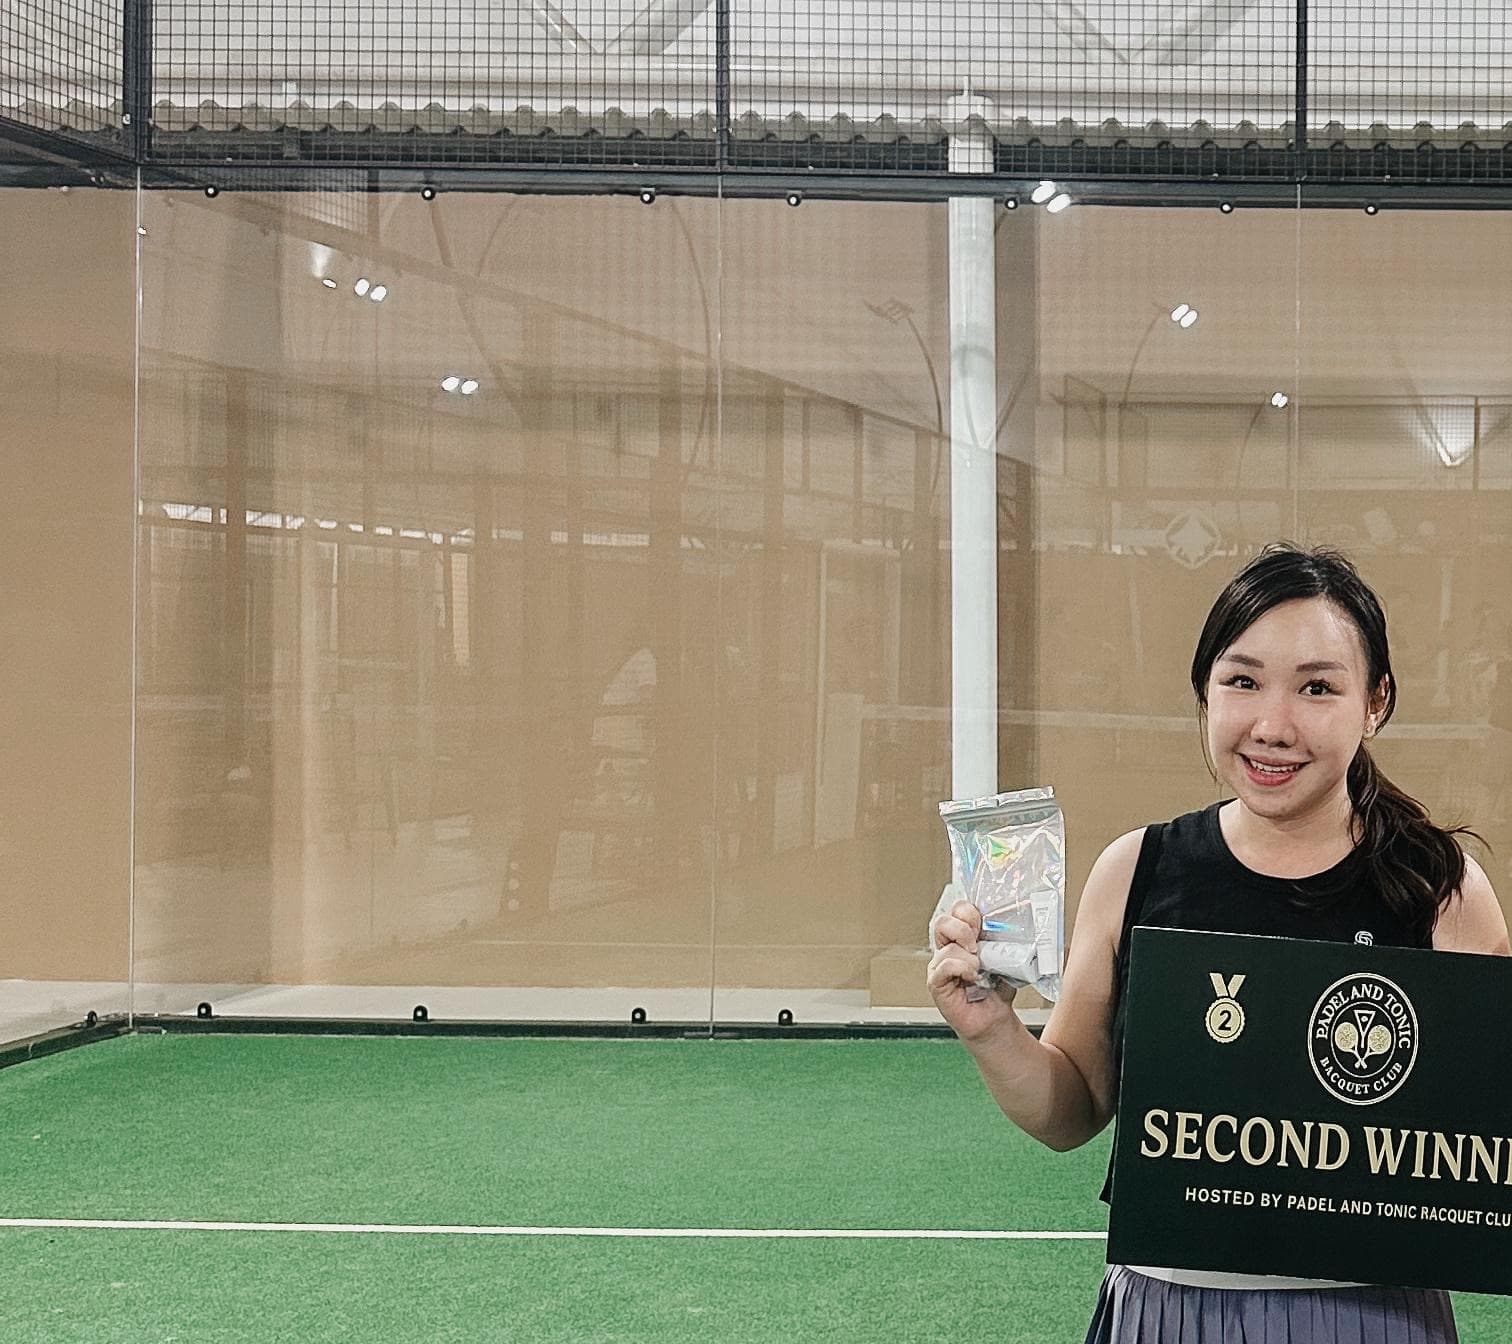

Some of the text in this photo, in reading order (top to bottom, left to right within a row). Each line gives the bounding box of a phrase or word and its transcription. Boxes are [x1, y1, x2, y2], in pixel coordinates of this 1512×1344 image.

[1217, 1009, 1232, 1032] 2
[1315, 983, 1412, 1049] PADEL AND TONIC
[1373, 1062, 1404, 1092] CLUB
[1140, 1108, 1350, 1170] SECOND
[1185, 1186, 1255, 1206] HOSTED
[1260, 1192, 1283, 1208] BY
[1287, 1195, 1337, 1213] PADEL
[1339, 1199, 1372, 1216] AND
[1375, 1202, 1417, 1219] TONIC
[1420, 1206, 1484, 1225] RACQUET
